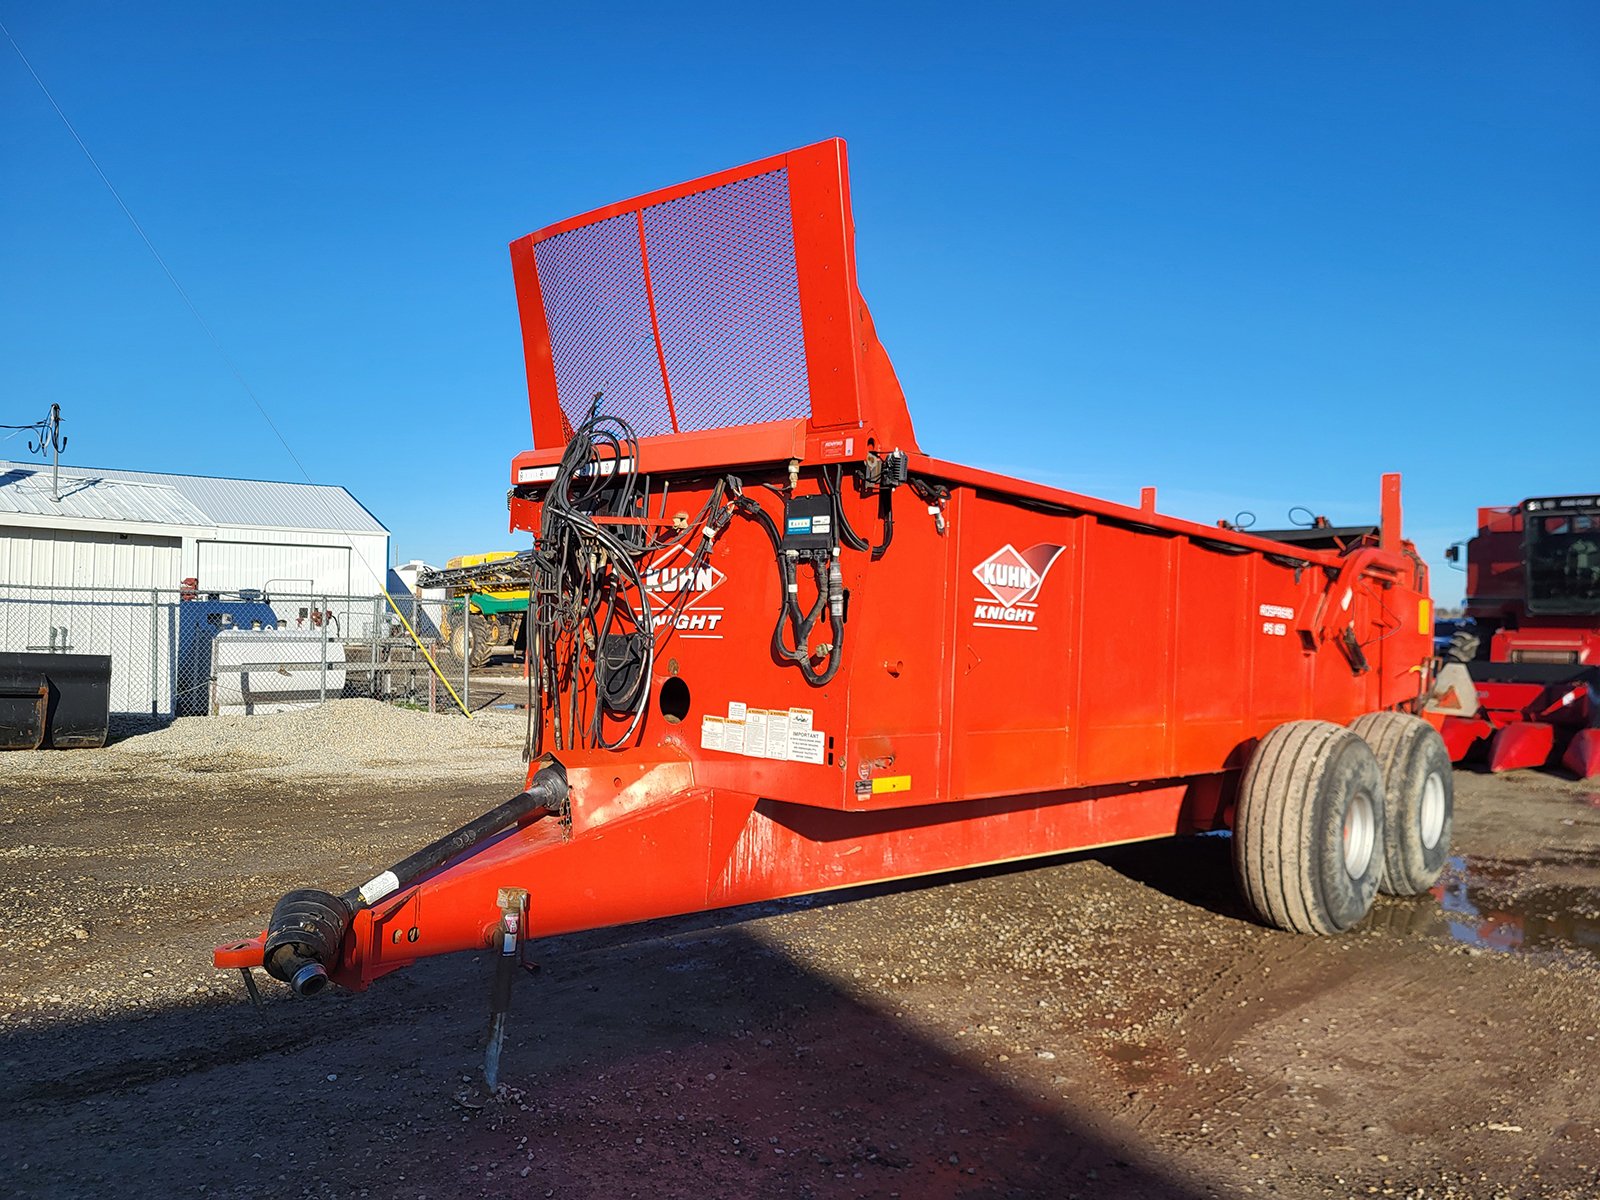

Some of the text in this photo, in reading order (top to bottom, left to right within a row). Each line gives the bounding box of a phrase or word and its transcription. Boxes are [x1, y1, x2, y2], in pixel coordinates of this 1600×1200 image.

[645, 567, 713, 592] KUHN
[983, 563, 1032, 589] KUHN
[637, 614, 722, 630] NIGHT
[974, 605, 1035, 623] KNIGHT
[792, 731, 819, 739] IMPORTANT
